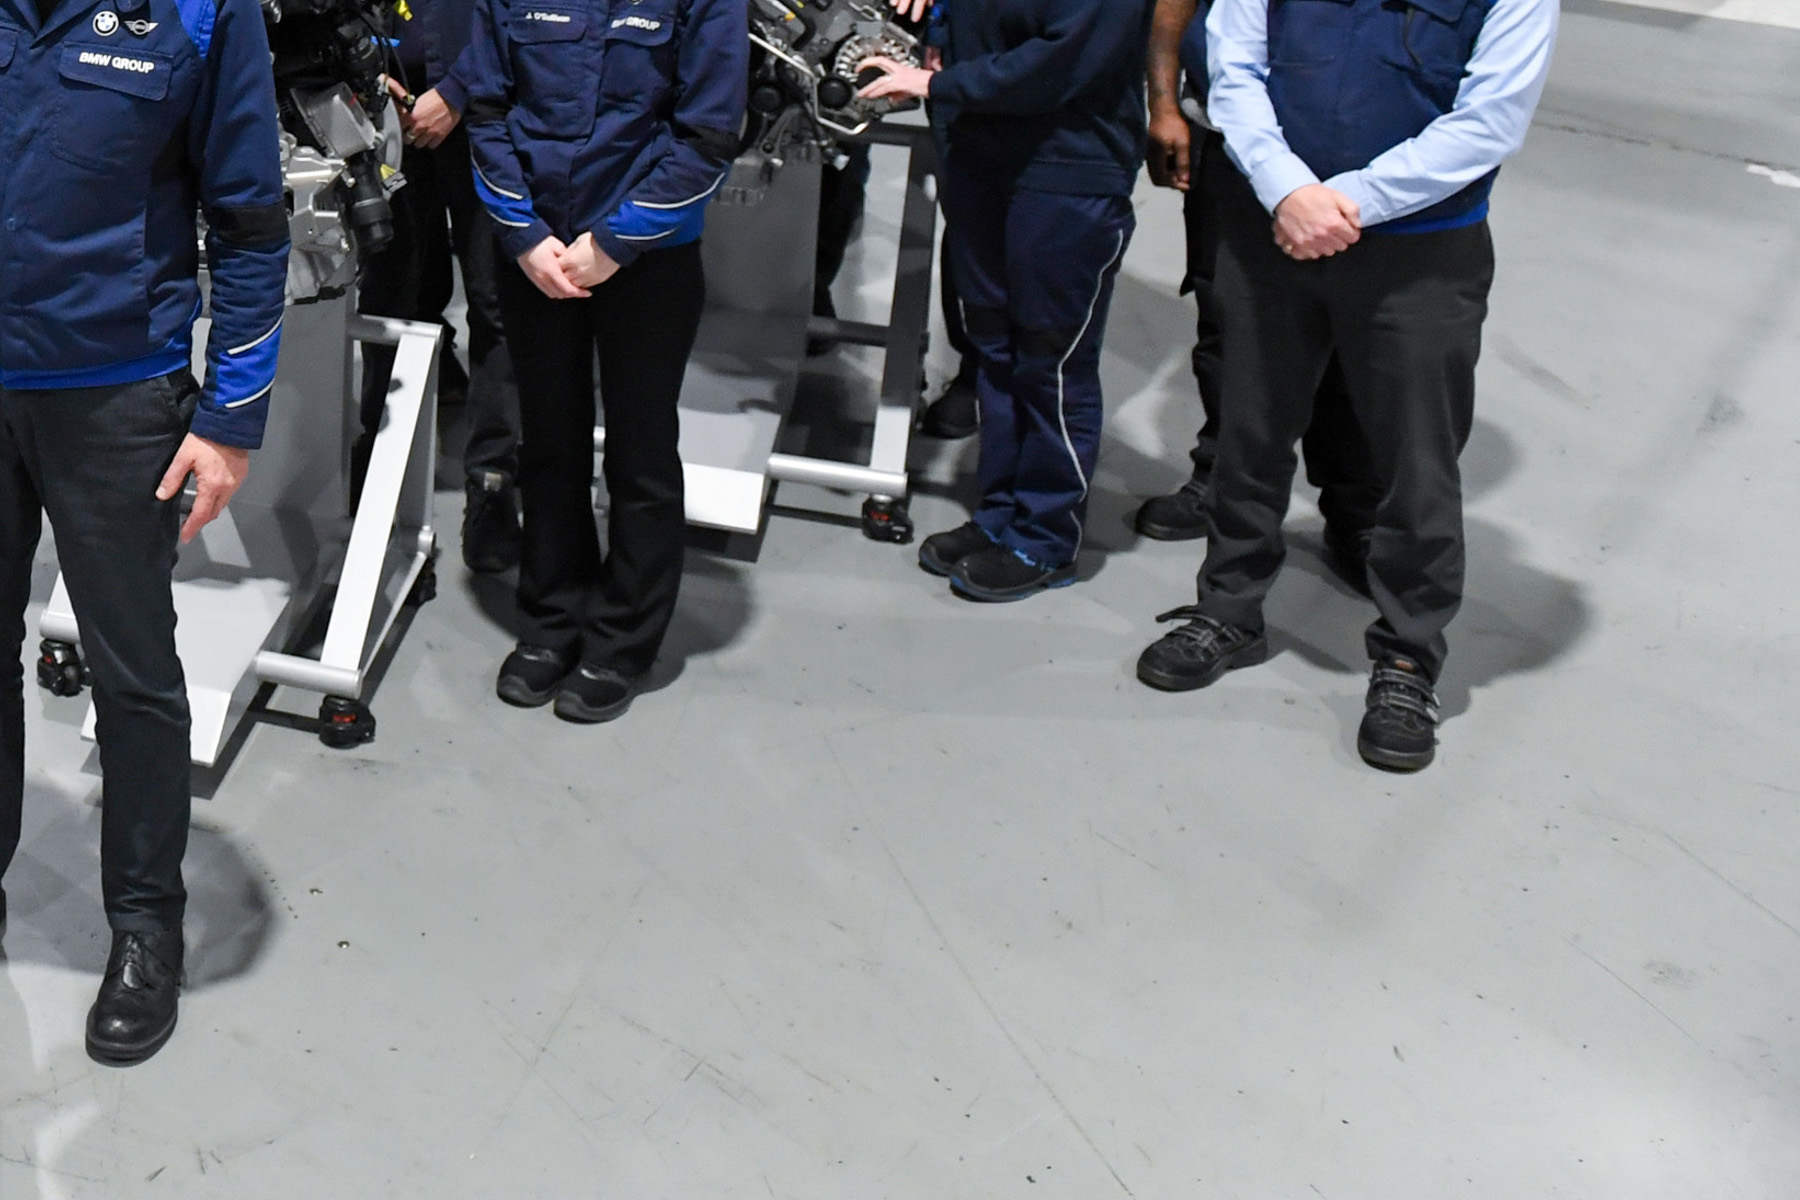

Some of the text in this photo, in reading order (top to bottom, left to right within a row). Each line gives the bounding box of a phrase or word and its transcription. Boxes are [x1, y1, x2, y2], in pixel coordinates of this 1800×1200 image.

[627, 17, 660, 30] GROUP
[79, 52, 154, 73] BMW GROUP
